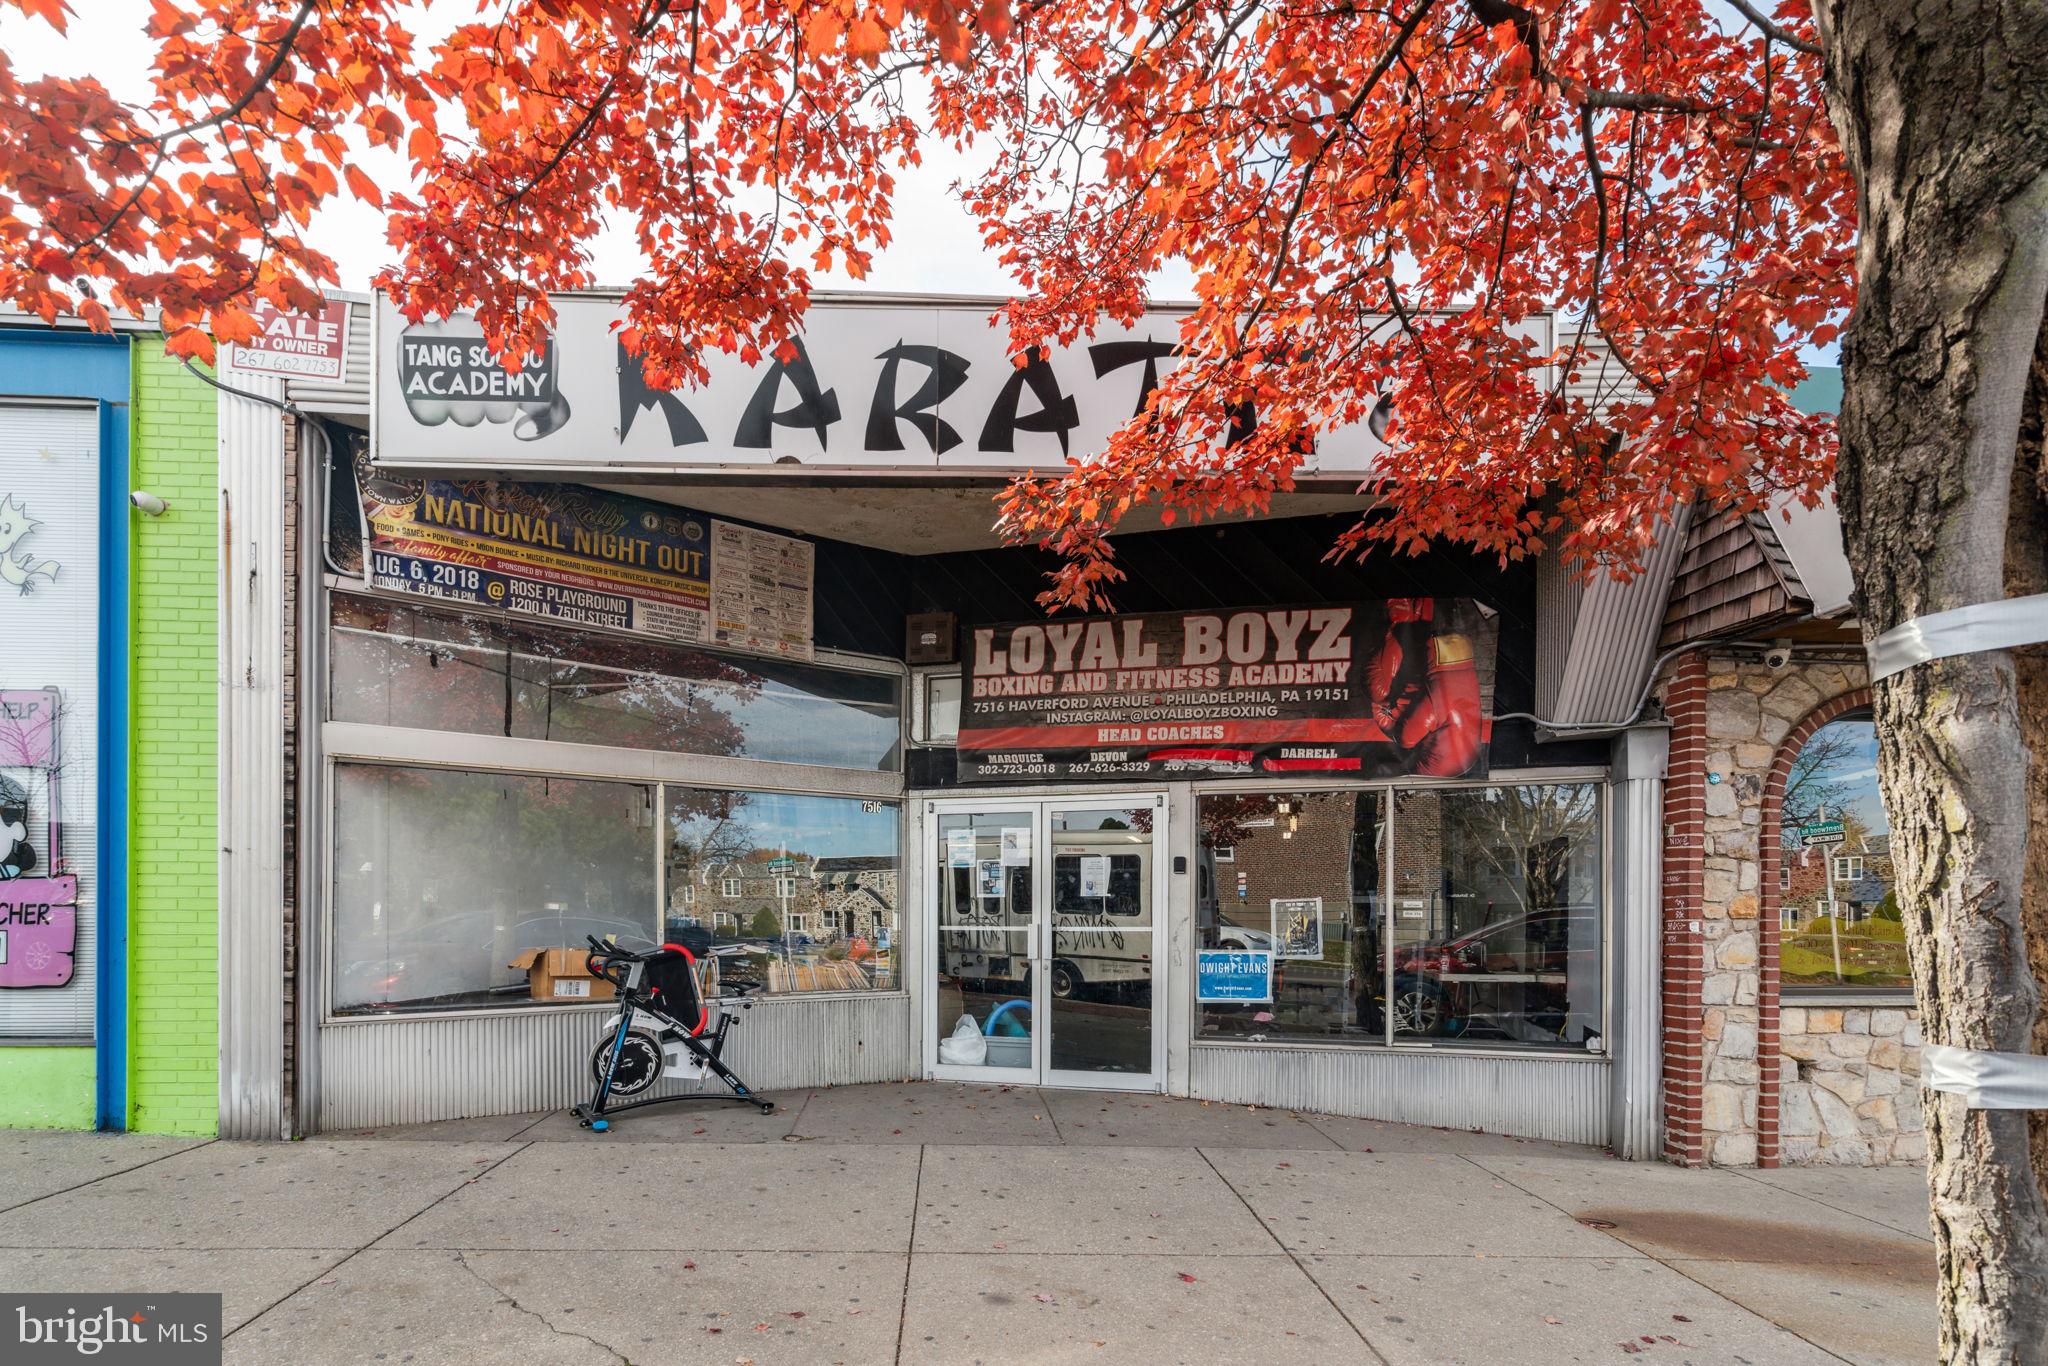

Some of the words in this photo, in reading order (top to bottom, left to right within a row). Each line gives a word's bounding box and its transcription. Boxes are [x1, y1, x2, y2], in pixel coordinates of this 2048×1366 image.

[272, 338, 328, 355] OWNER
[405, 344, 462, 367] TANG
[237, 350, 265, 367] 267
[273, 356, 299, 370] 602
[406, 371, 548, 397] ACADEMY
[364, 485, 386, 502] TOWN
[388, 495, 416, 505] WATCH
[425, 495, 565, 549] NATIONAL
[574, 527, 650, 566] NIGHT
[657, 545, 704, 577] OUT
[376, 522, 394, 533] FOOD
[401, 527, 425, 538] GAMES
[432, 532, 450, 543] PONY
[450, 536, 469, 548] RIDES
[476, 542, 495, 553] MOON
[495, 546, 519, 558] BOUNCE
[526, 552, 545, 563] MUSIC
[556, 558, 581, 570] RICHARD
[581, 563, 604, 575] TUCKER
[608, 569, 620, 578] THE
[620, 571, 649, 584] UNIVERSAL
[674, 581, 691, 591] MUSIC
[401, 540, 447, 560] family
[375, 554, 405, 577] UG.
[410, 560, 427, 583] 6,
[433, 564, 480, 590] 2018
[497, 561, 534, 575] SPONSORED
[535, 568, 544, 577] BY
[544, 570, 561, 580] YOUR
[418, 583, 425, 594] 5
[427, 584, 443, 597] PM
[452, 589, 459, 599] 9
[461, 591, 476, 602] PM
[487, 581, 505, 600] @
[510, 579, 543, 600] ROSE
[546, 586, 627, 614] PLAYGROUND
[510, 596, 540, 614] 1200
[556, 605, 585, 622] 75TH
[588, 609, 628, 629] STREET
[637, 601, 657, 611] THANKS
[658, 604, 665, 612] TO
[665, 606, 674, 614] THE
[675, 608, 694, 618] OFFICES
[973, 619, 1158, 676] LOYAL
[1182, 608, 1352, 666] BOYZ
[972, 674, 1054, 697] BOXING
[1060, 672, 1107, 693] AND
[1115, 666, 1220, 691] FITNESS
[1228, 661, 1351, 687] ACADEMY
[973, 701, 1005, 713] 7516
[1008, 698, 1089, 712] HAVERFORD
[1092, 695, 1150, 709] AVENUE
[1166, 691, 1276, 706] PHILADELPHIA,
[1281, 690, 1300, 702] PA
[1305, 688, 1349, 701] 19151
[1046, 710, 1126, 724] INSTAGRAM:
[1130, 705, 1278, 723] @LOYALBOYZBOXING
[1098, 728, 1141, 743] HEAD
[1146, 725, 1224, 741] COACHES
[988, 753, 1044, 764] MARQUICE
[1090, 752, 1128, 762] DEVON
[1281, 748, 1338, 759] DARRELL
[978, 763, 1056, 775] 302-723-0018
[1069, 762, 1150, 773] 267-626-3329
[862, 800, 883, 814] 7516
[1200, 962, 1235, 974] DWIGHT
[1238, 962, 1267, 974] EVANS
